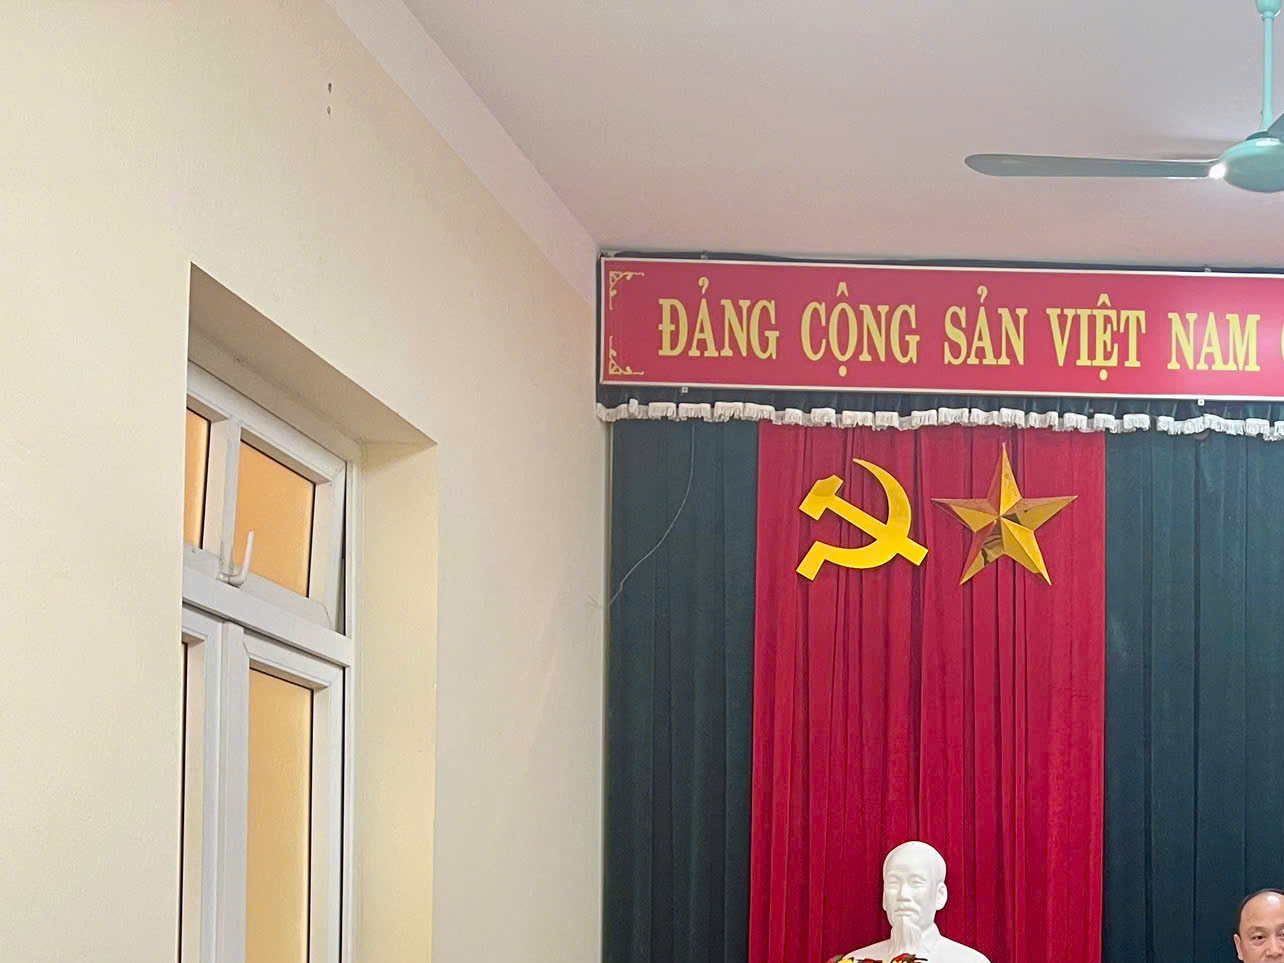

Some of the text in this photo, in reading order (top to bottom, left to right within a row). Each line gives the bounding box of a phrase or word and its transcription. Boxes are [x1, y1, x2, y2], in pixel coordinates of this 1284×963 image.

[658, 276, 780, 359] ĐẢNG
[801, 282, 921, 377] CỘNG
[943, 286, 1028, 366] SẢN
[1046, 293, 1147, 381] VIỆT
[1167, 311, 1262, 372] NAM
